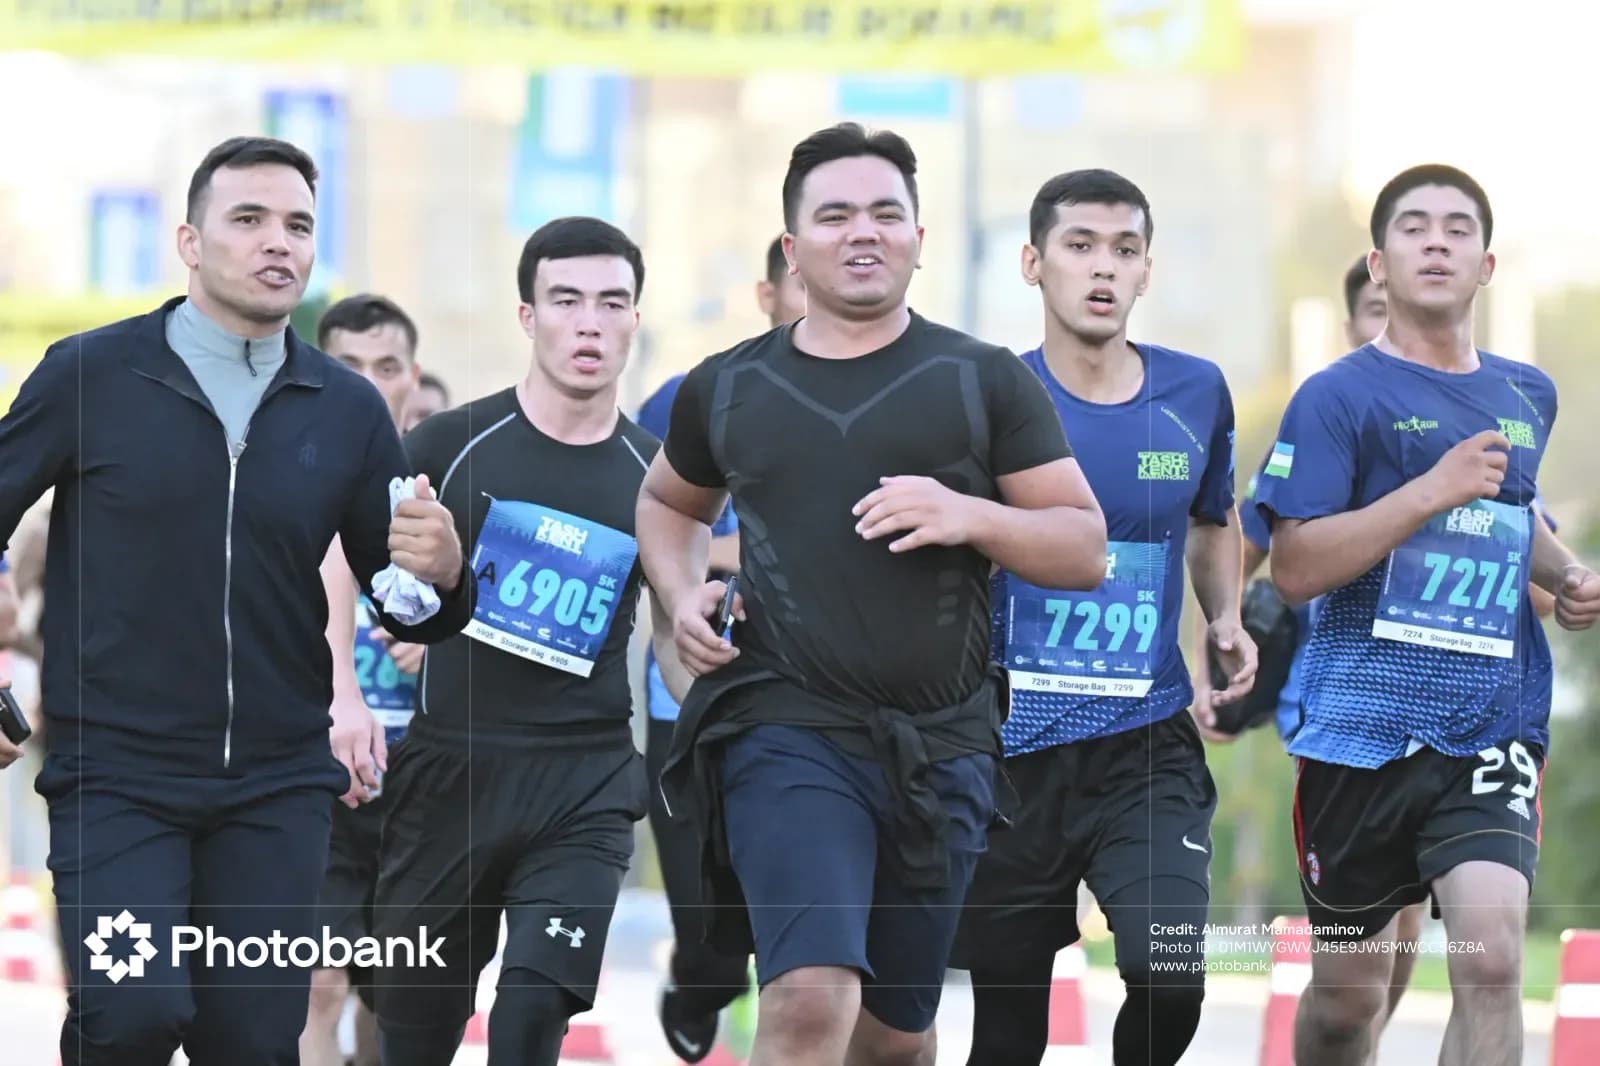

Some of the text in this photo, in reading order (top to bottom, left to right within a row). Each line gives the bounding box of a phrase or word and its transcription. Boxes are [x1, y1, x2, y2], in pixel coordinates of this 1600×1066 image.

[1419, 420, 1439, 429] RUN
[1137, 452, 1183, 467] TASH
[1138, 464, 1182, 477] KENT
[1446, 515, 1491, 535] KENT
[1450, 506, 1494, 526] TASH
[477, 561, 496, 586] A
[598, 574, 618, 590] 5K
[1420, 551, 1518, 614] 7274
[499, 559, 616, 635] 6905
[1137, 590, 1157, 602] 5K
[1045, 598, 1158, 653] 7299
[1402, 628, 1423, 640] 7274
[1429, 634, 1460, 647] Storage
[1459, 637, 1473, 649] Bag
[500, 636, 530, 653] Storage
[550, 652, 570, 667] 6905
[1031, 677, 1134, 693] 7299 Storage Bag 7299
[1472, 741, 1538, 799] 29
